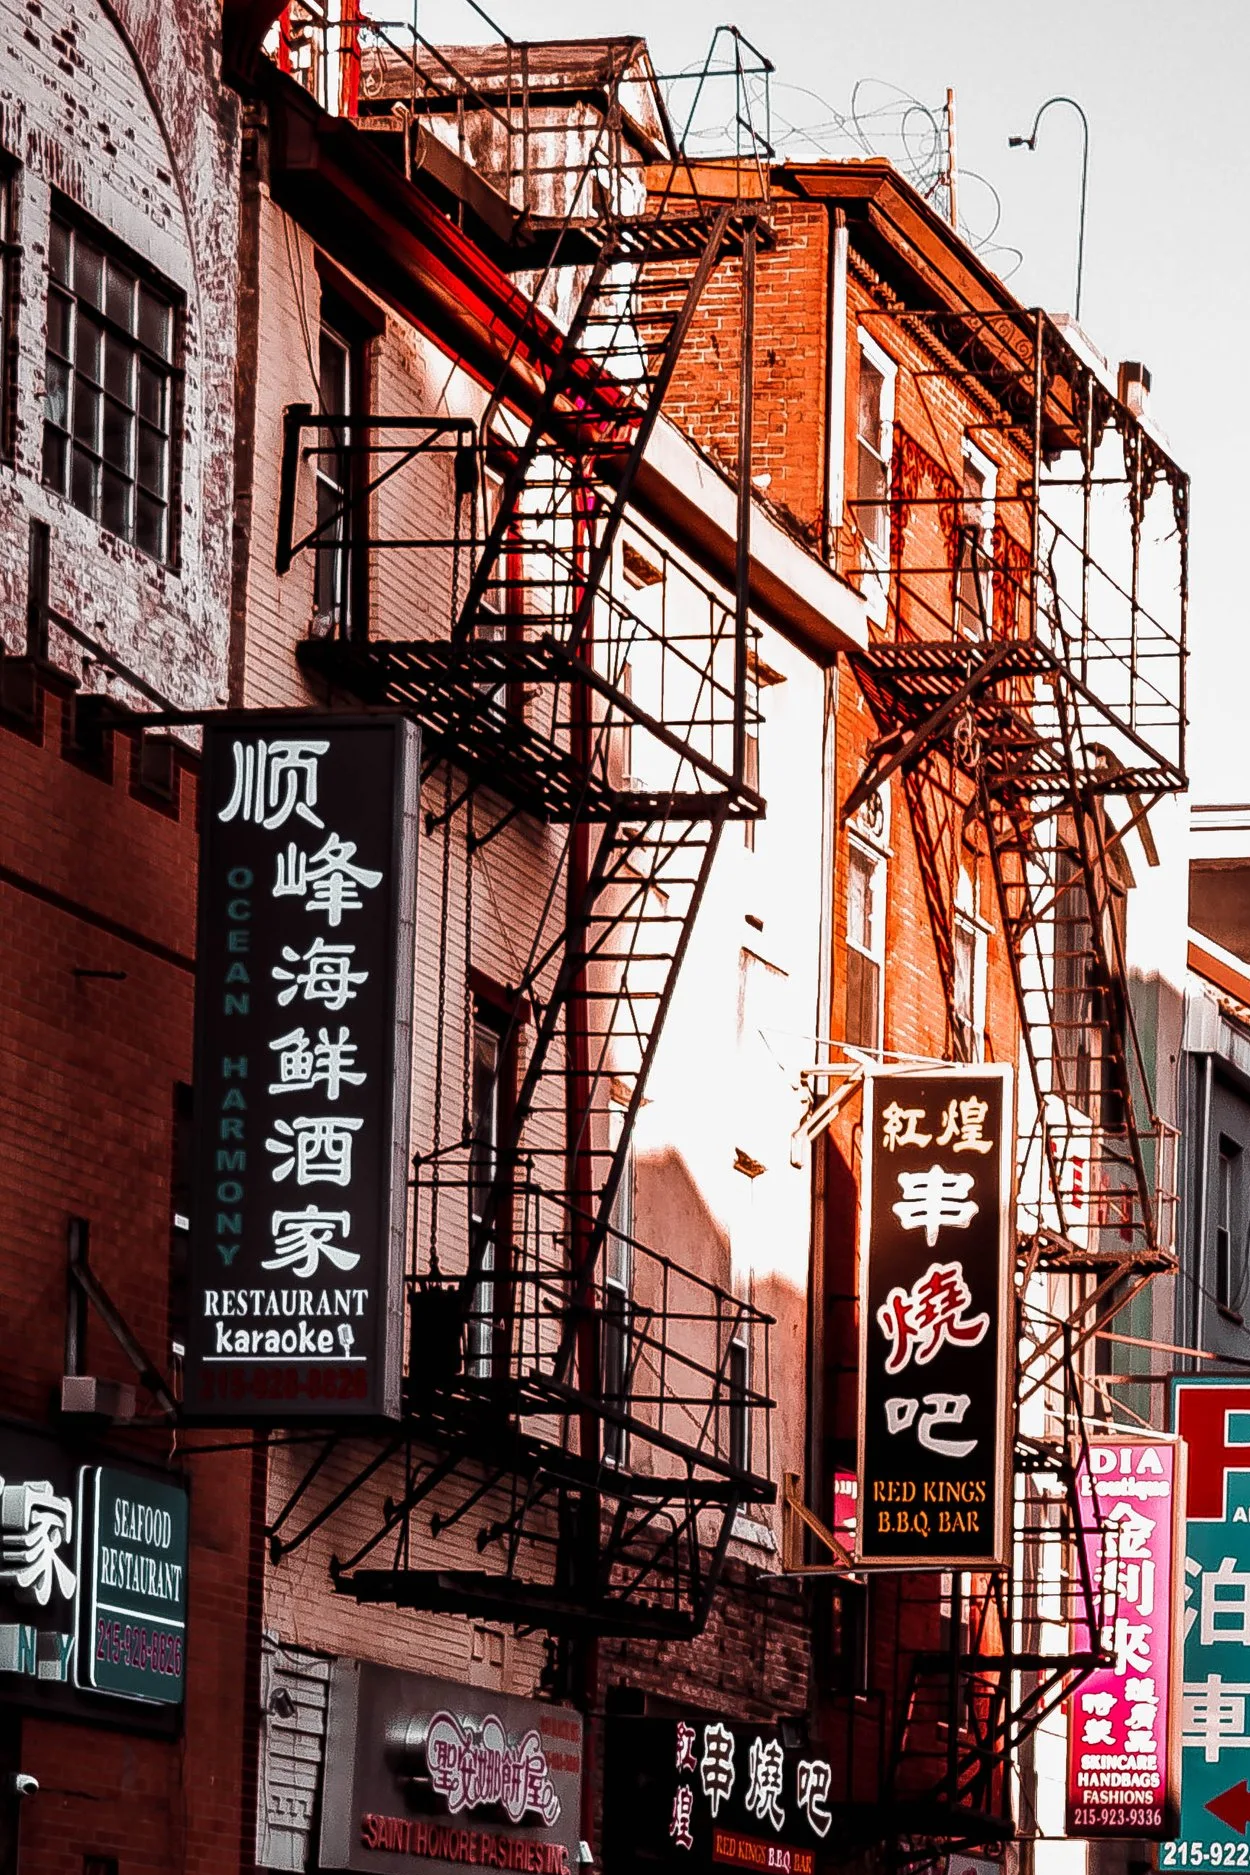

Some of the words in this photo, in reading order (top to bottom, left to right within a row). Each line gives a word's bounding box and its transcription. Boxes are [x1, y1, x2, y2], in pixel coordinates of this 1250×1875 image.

[223, 866, 254, 1016] OCEAN
[882, 1095, 994, 1154] 紅煌
[216, 1056, 249, 1266] HARMONY
[204, 1289, 369, 1317] RESTAURANT
[876, 1164, 991, 1458] 串燒吧
[216, 1321, 334, 1353] karaoke
[873, 1481, 916, 1502] RED
[924, 1481, 987, 1503] KINGS
[114, 1497, 171, 1549] SEAFOOD
[938, 1511, 980, 1533] BAR
[101, 1546, 182, 1602] RESTAURANT
[97, 1617, 183, 1678] 215-928-8826
[1078, 1772, 1160, 1788] HANDBAGS
[1081, 1754, 1157, 1771] SKINCARE
[1083, 1790, 1154, 1805] FASHIONS
[362, 1813, 412, 1852] SAINT
[416, 1822, 477, 1864] HONORE
[480, 1831, 543, 1875] PASTRIES
[716, 1834, 736, 1858] RED
[738, 1840, 767, 1866] KINGS
[793, 1852, 812, 1875] BAR
